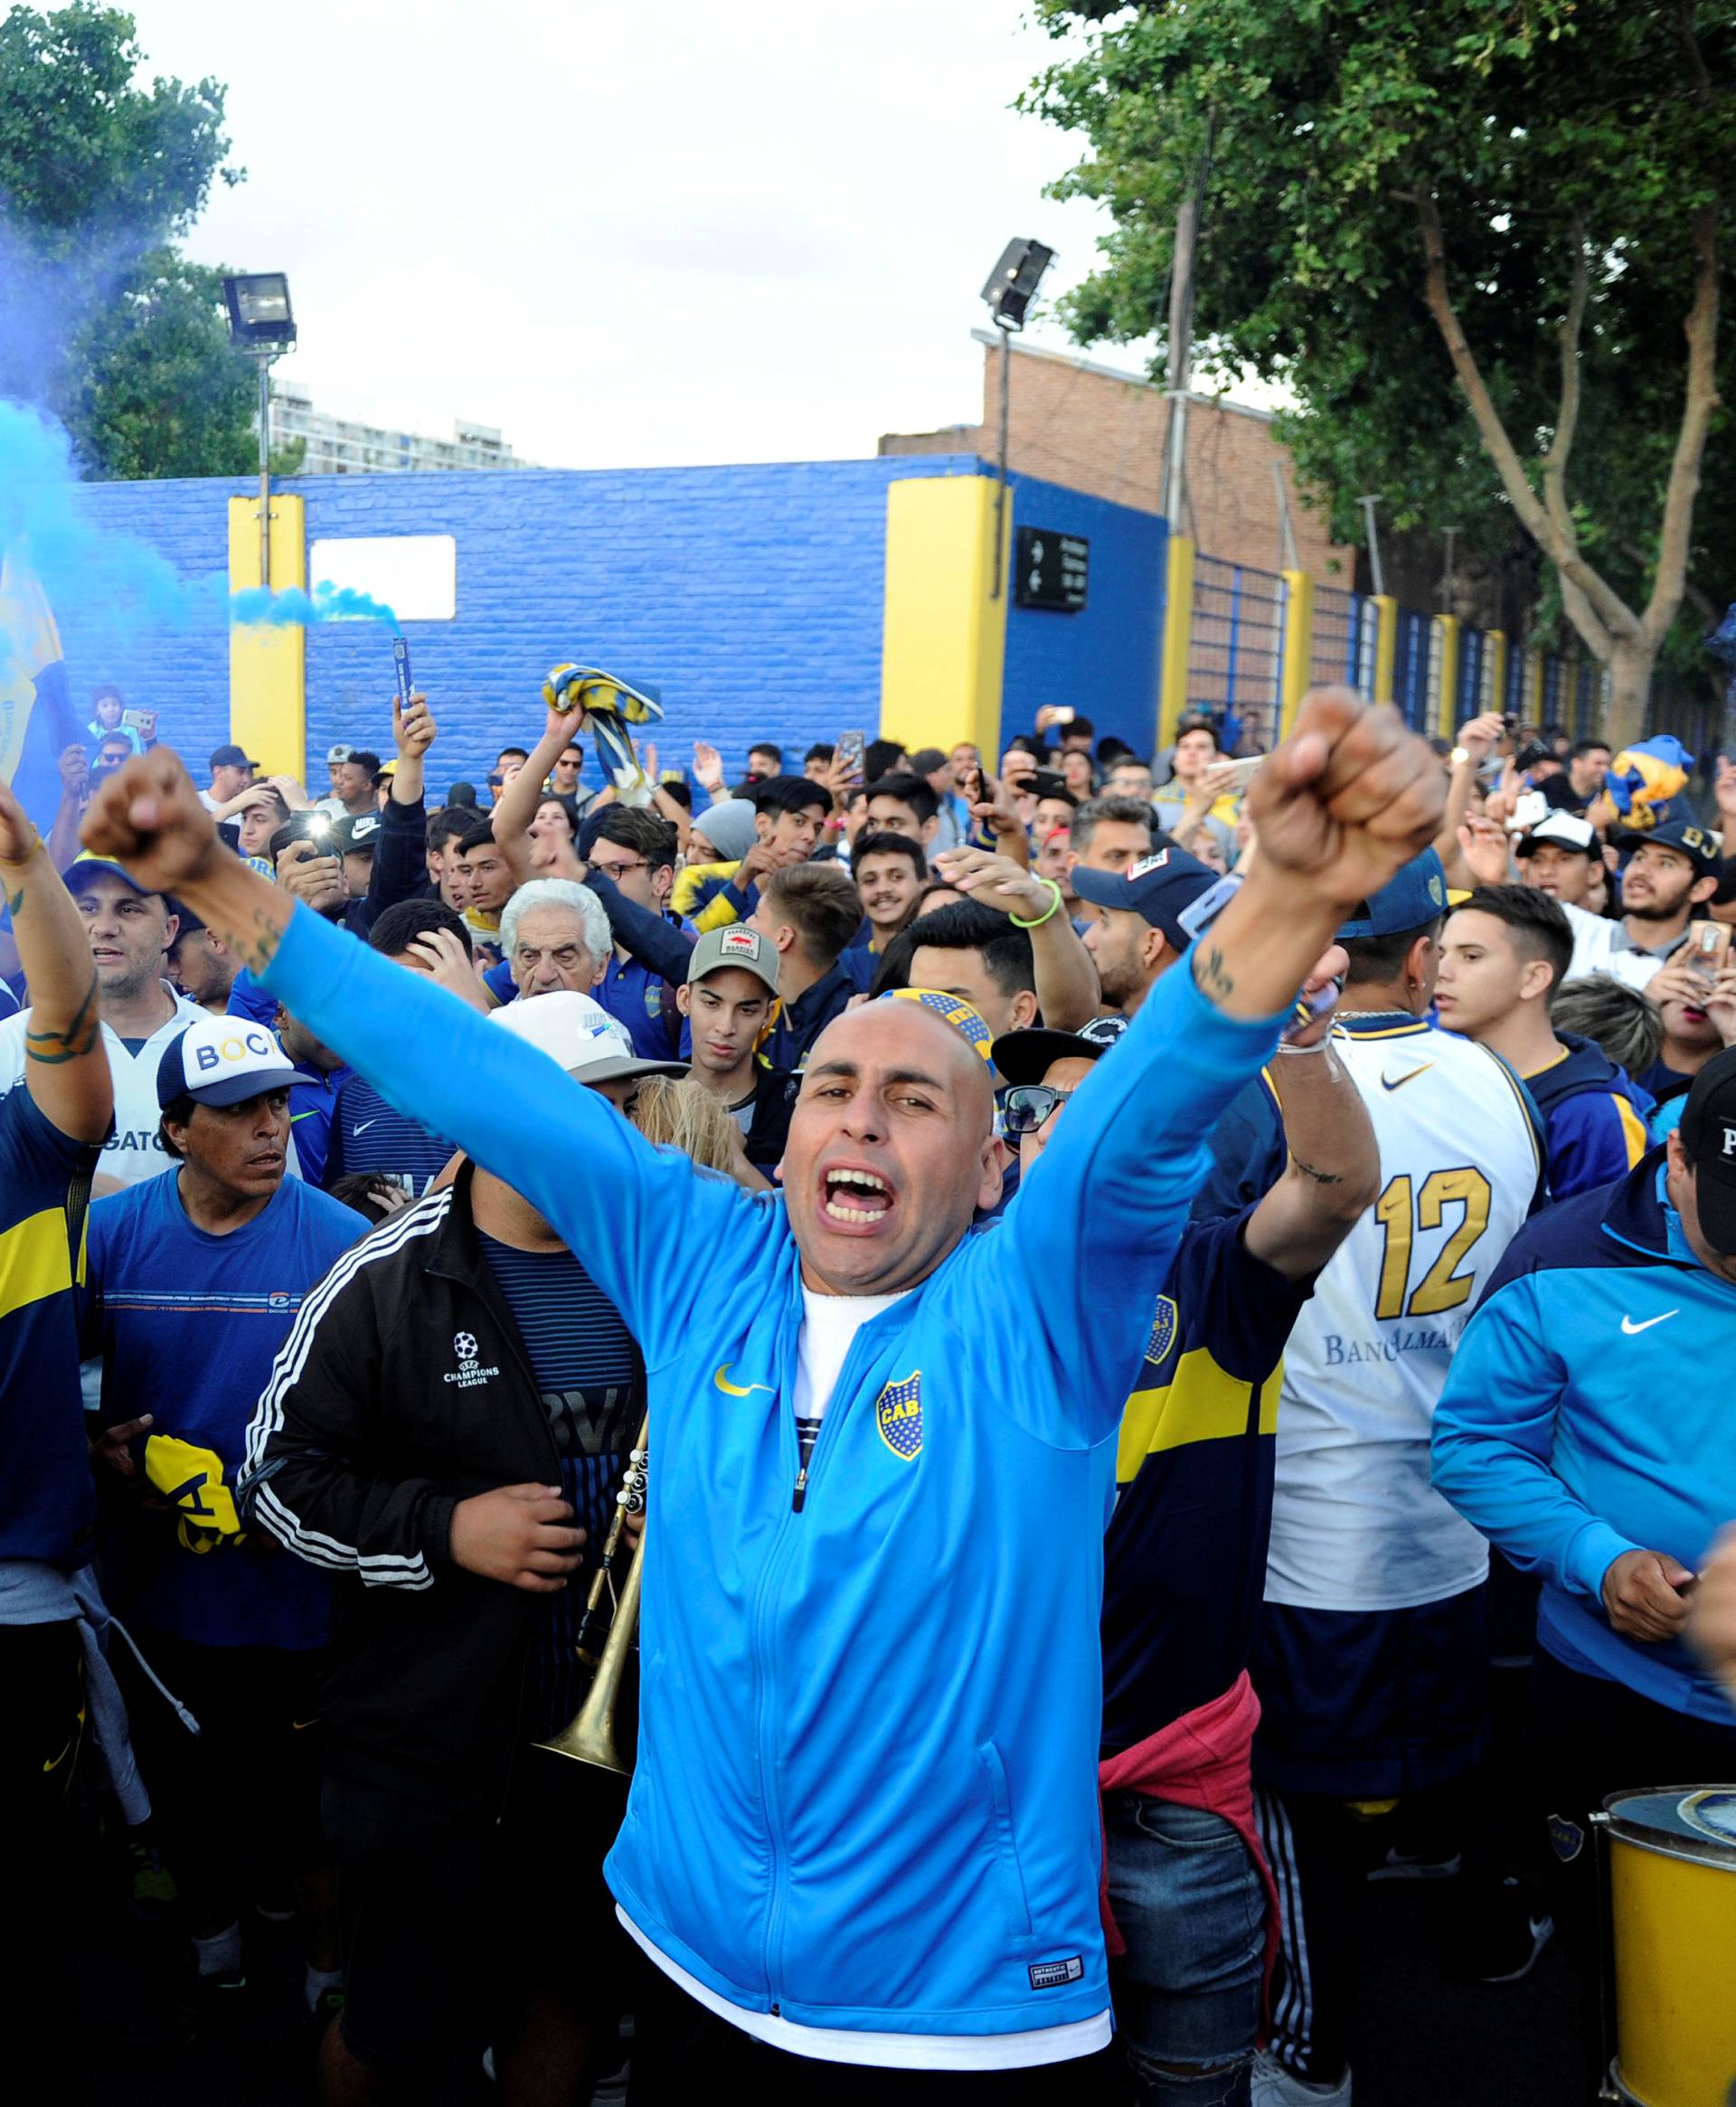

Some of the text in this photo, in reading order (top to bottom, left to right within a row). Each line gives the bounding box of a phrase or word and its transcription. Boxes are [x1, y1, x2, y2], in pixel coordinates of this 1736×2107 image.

[1374, 1166, 1491, 1320] 12
[443, 1366, 499, 1383] CHAMPIONS
[458, 1377, 488, 1388] LEAGUE
